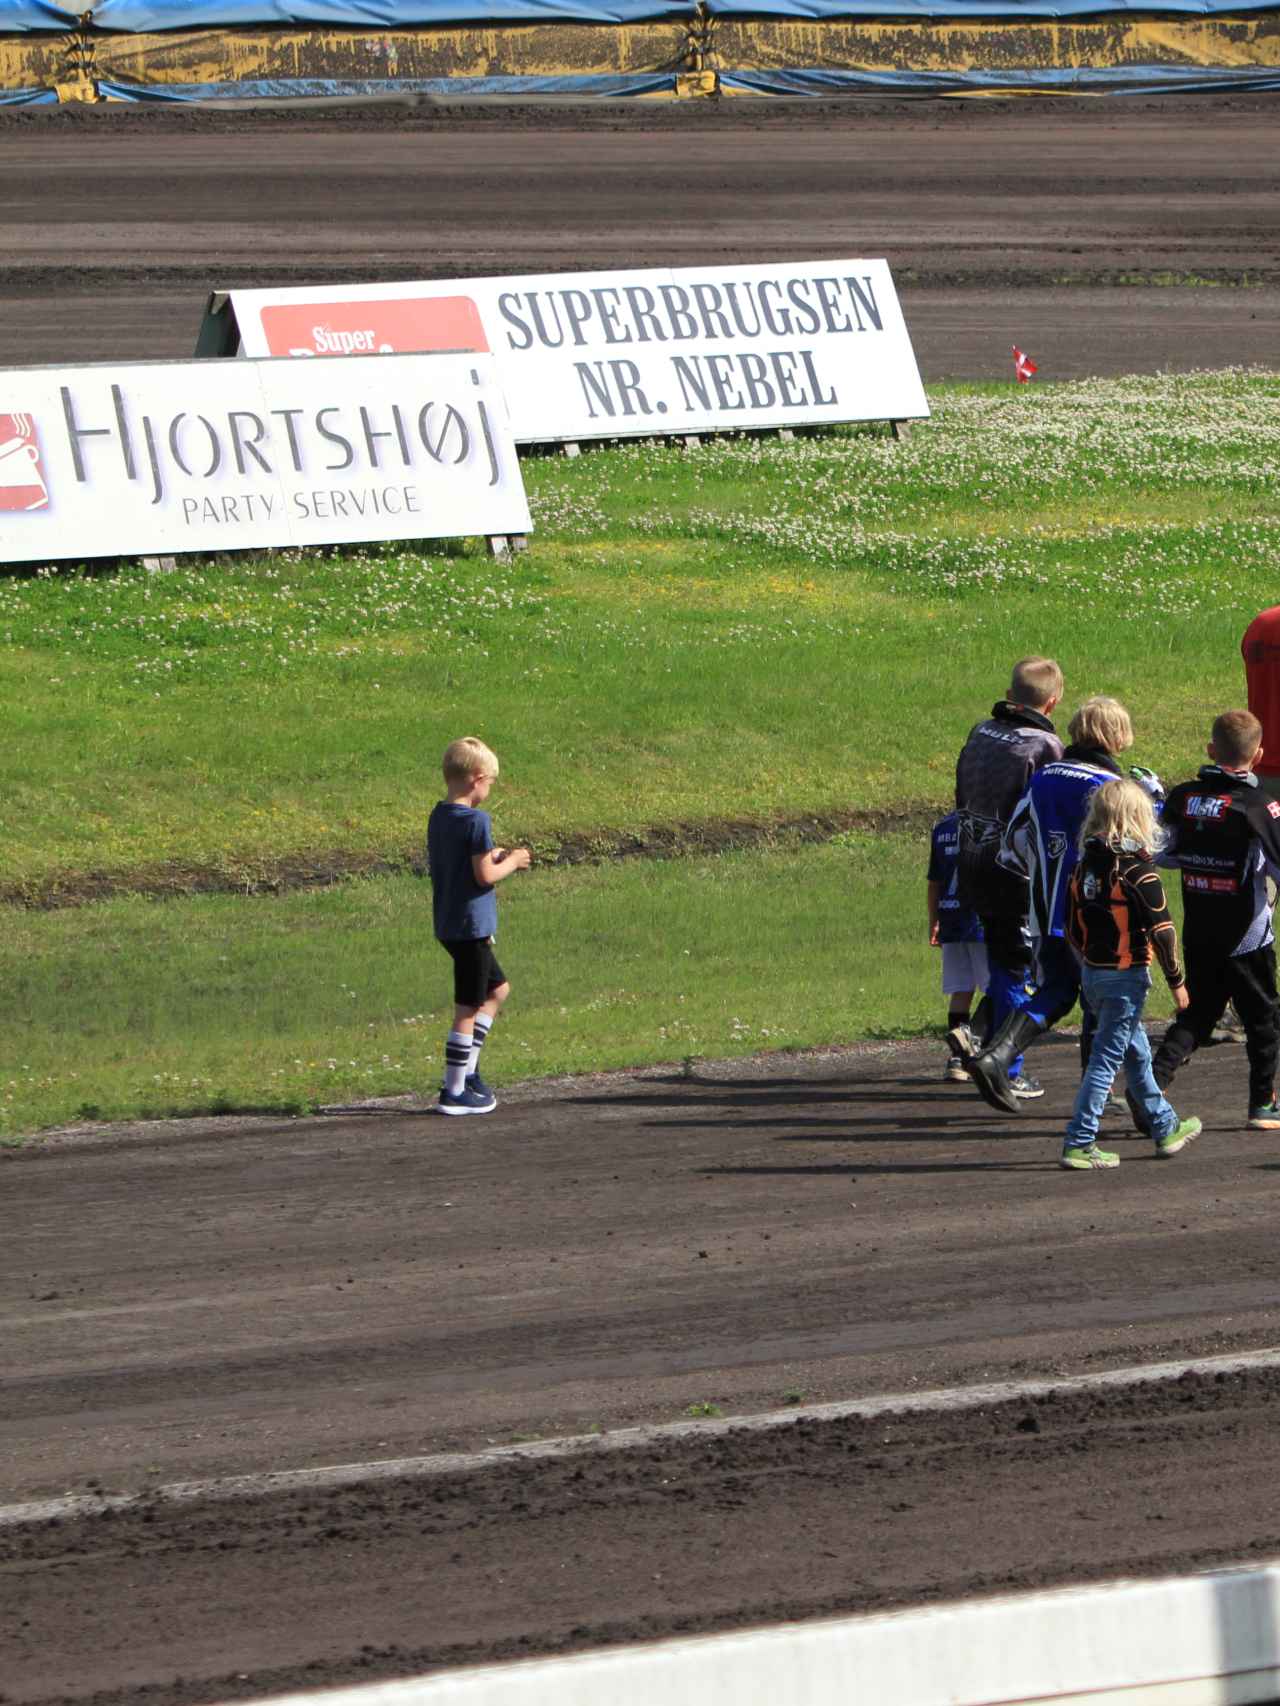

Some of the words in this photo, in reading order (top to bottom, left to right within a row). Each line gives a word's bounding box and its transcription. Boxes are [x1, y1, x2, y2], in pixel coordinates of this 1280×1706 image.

[498, 276, 884, 349] SUPERBRUGSEN
[312, 326, 375, 353] Super
[573, 358, 668, 418] NR.
[670, 350, 839, 413] NEBEL
[183, 493, 275, 525] PARTY
[294, 486, 421, 519] SERVICE
